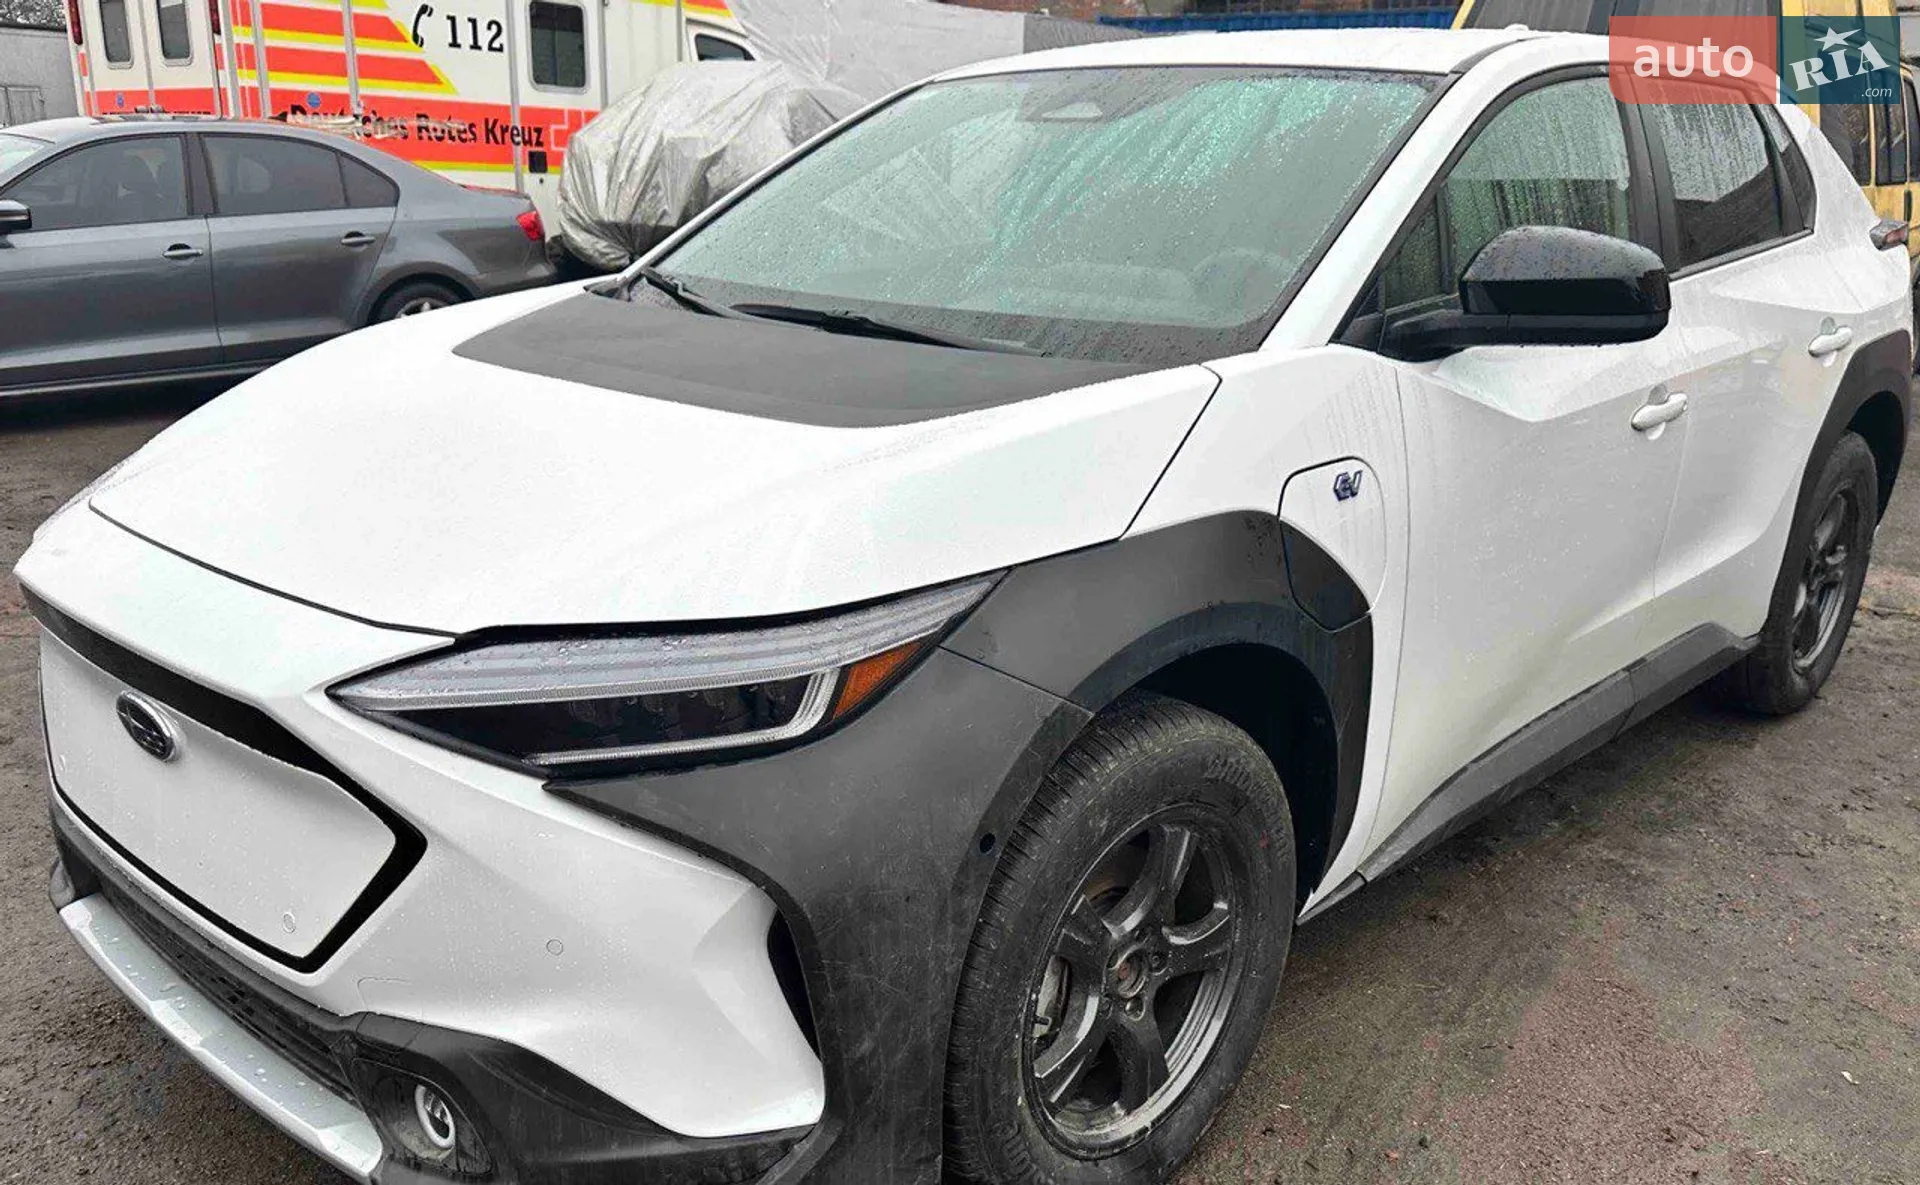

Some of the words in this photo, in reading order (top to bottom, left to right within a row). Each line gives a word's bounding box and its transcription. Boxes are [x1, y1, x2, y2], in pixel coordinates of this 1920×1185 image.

[446, 14, 504, 53] 112
[416, 113, 477, 143] Rotes
[484, 117, 544, 147] Kreuz
